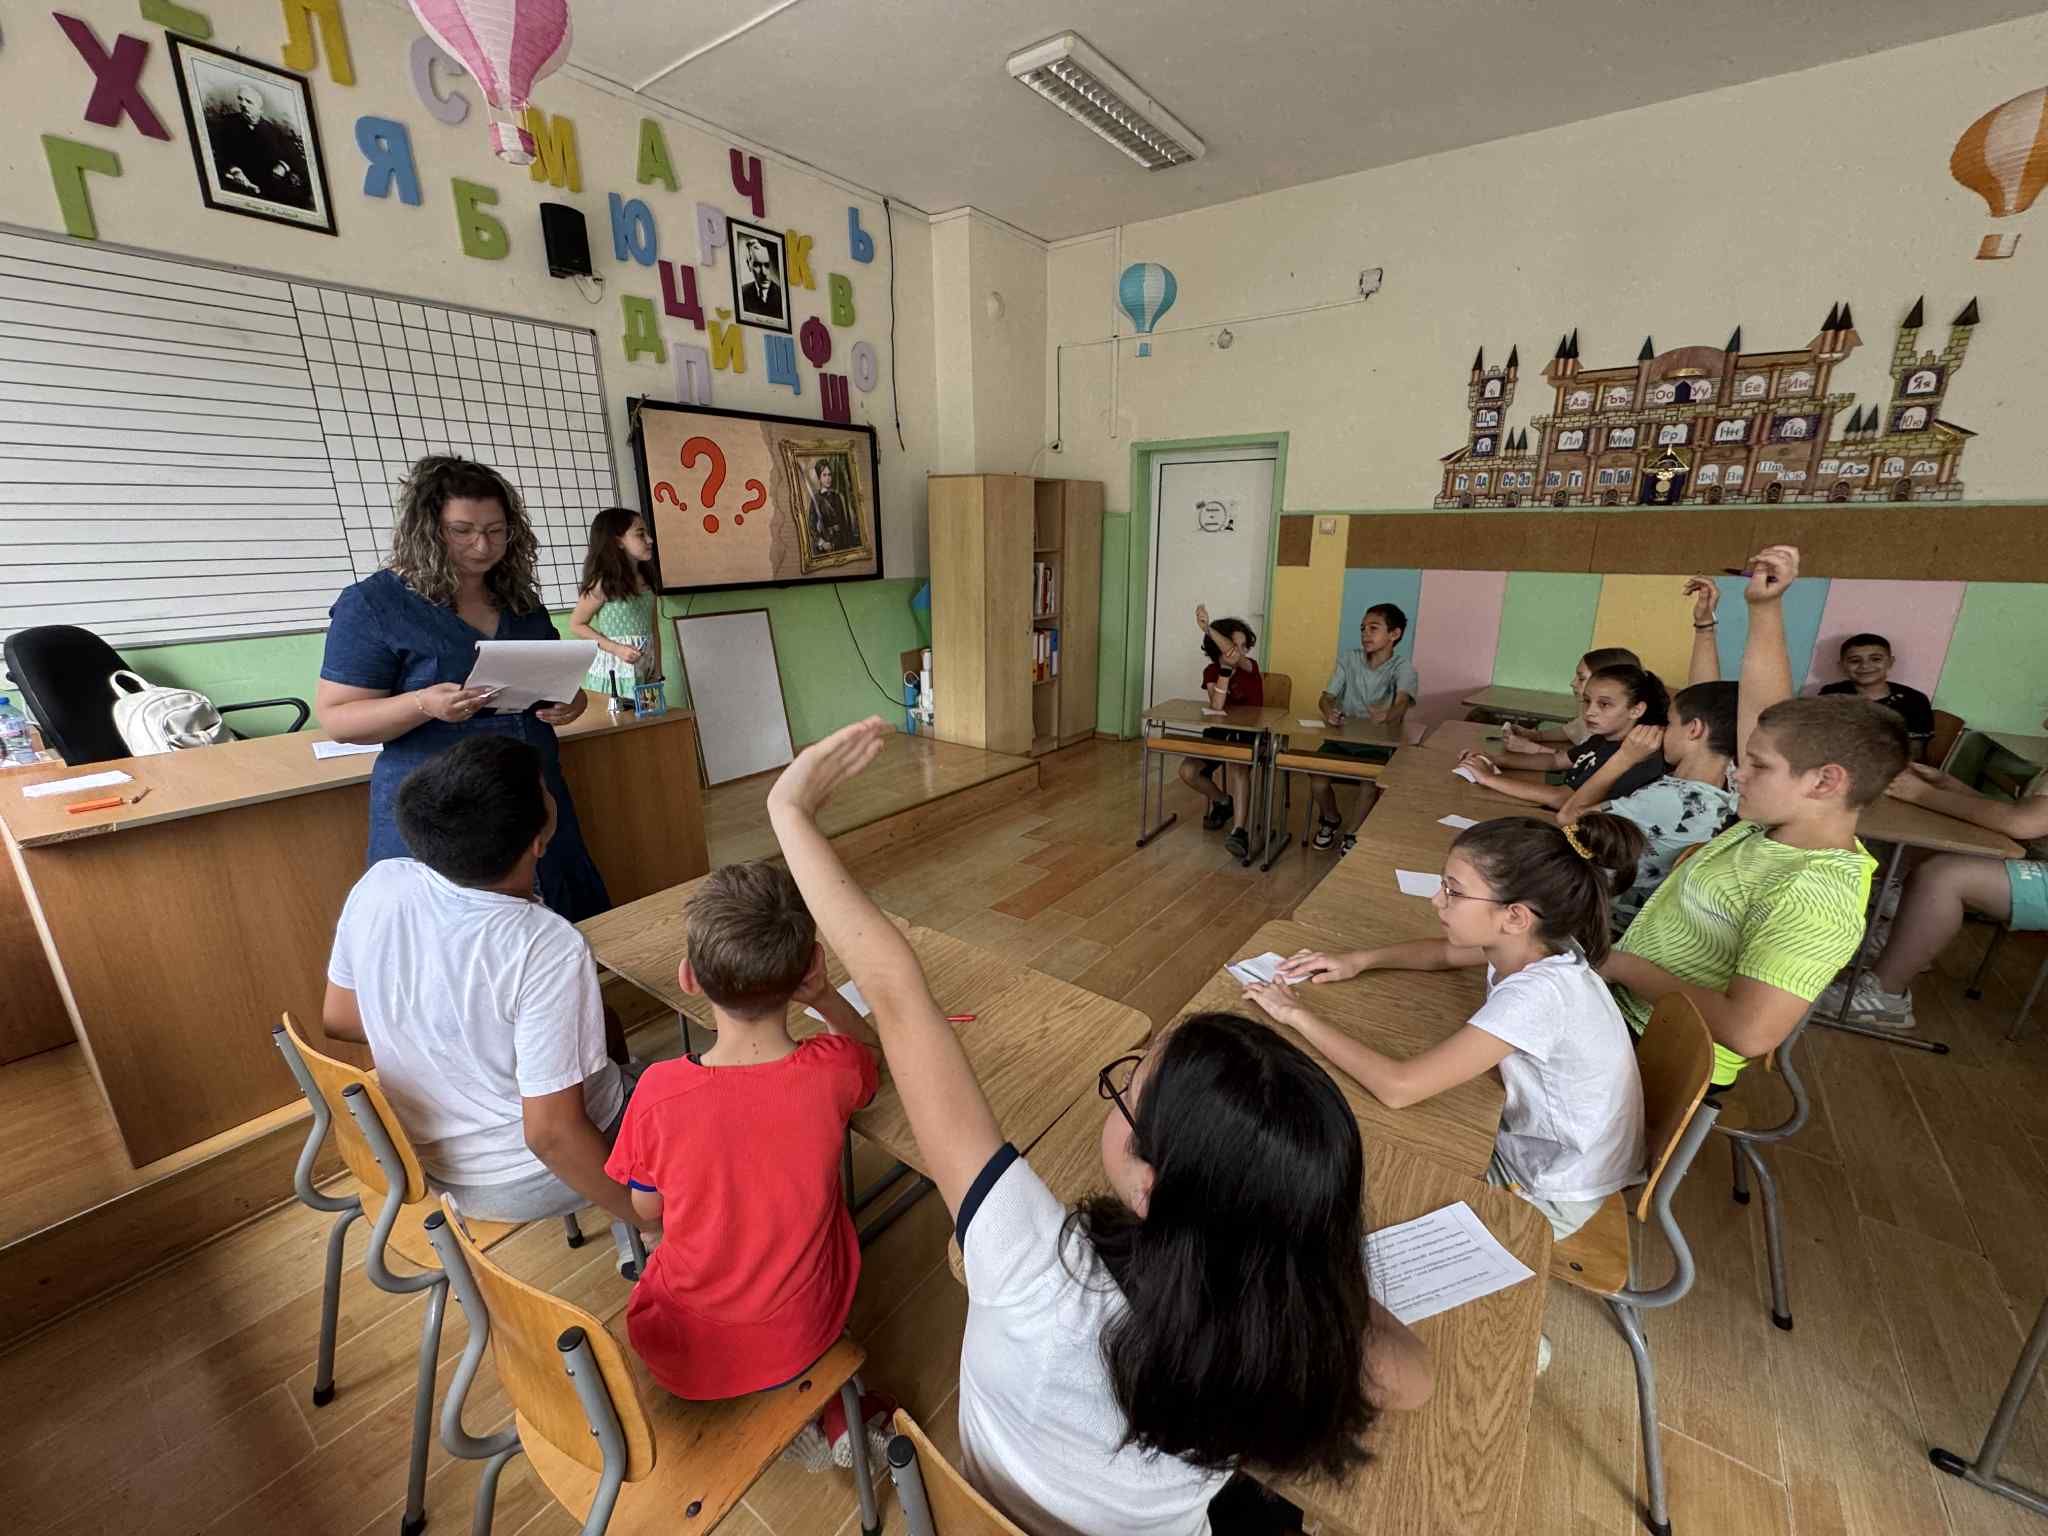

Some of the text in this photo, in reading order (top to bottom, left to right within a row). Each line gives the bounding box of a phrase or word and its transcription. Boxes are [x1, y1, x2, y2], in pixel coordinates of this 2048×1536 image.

[52, 12, 171, 142] Х
[281, 0, 355, 87] Л
[410, 36, 471, 125] С
[355, 116, 423, 207] Я
[526, 106, 583, 193] М
[637, 118, 678, 192] А
[729, 148, 765, 218] Ч
[41, 134, 122, 240] Г
[451, 177, 510, 260] Б
[608, 192, 658, 267] Ю
[697, 202, 729, 266] Р
[786, 230, 817, 290] К
[621, 295, 666, 364] Д
[658, 260, 706, 330] Ц
[829, 272, 855, 328] В
[673, 342, 712, 404] П
[707, 307, 746, 373] Й
[763, 335, 801, 395] Щ
[800, 316, 832, 369] Ф
[851, 341, 877, 393] О
[819, 373, 851, 424] Ш
